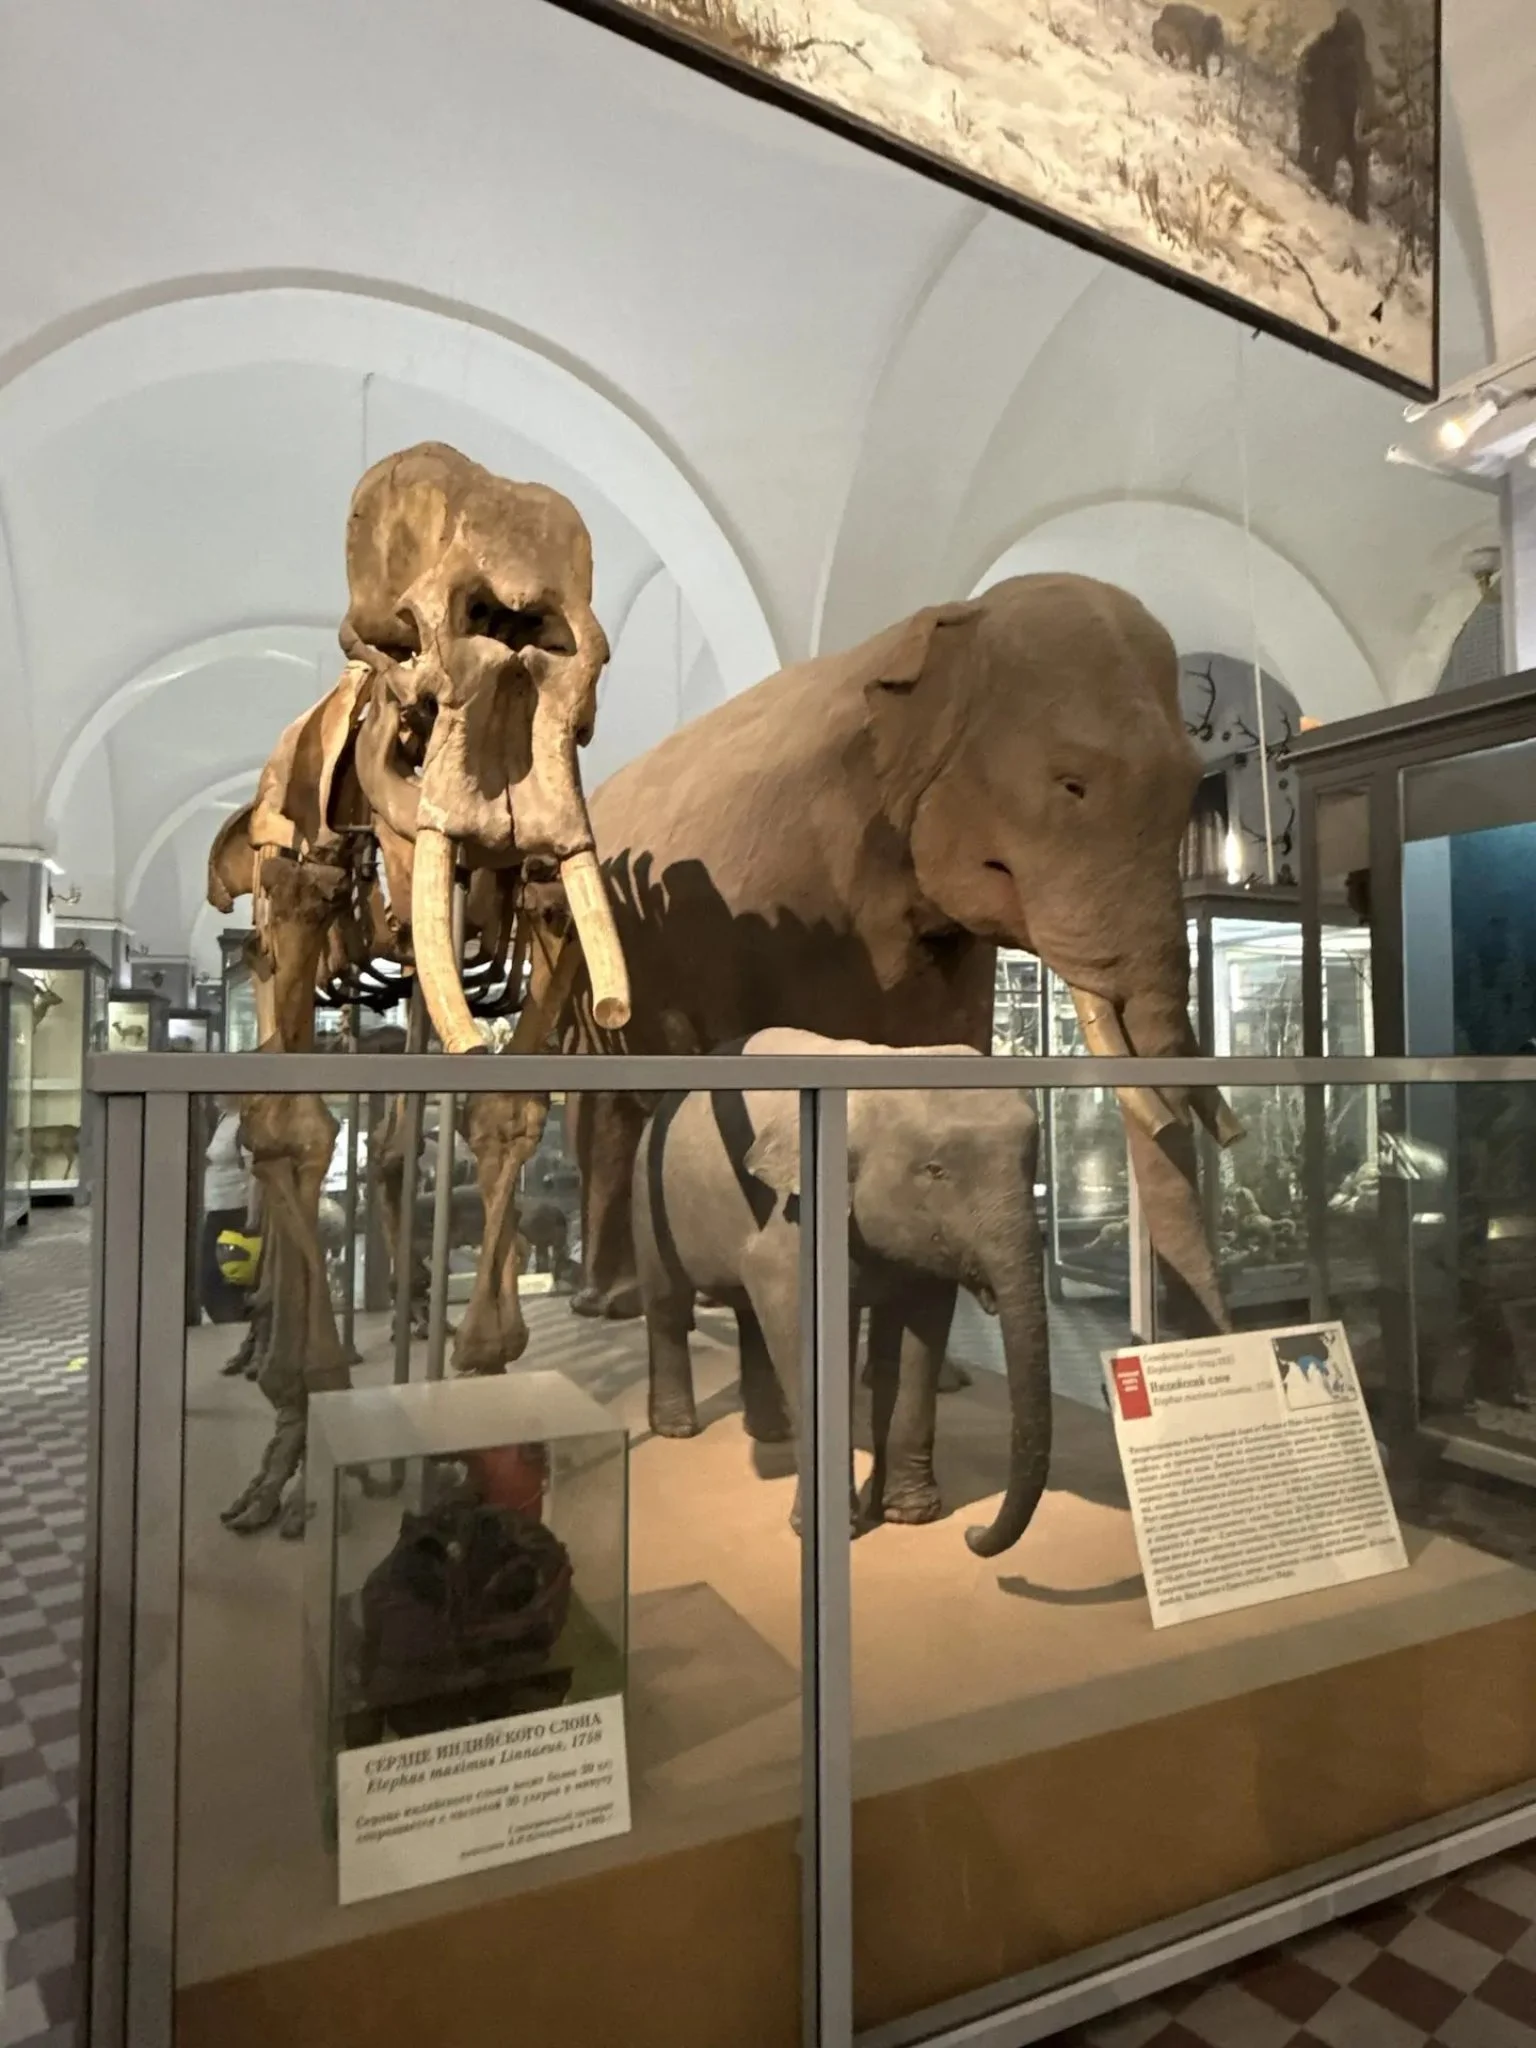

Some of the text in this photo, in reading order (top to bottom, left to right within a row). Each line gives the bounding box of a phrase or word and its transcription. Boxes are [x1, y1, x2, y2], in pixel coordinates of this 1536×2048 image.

[364, 1712, 602, 1775] СЕРДЦЕ ИНДИЙСКОГО СЛОНА
[366, 1771, 426, 1795] Elephas
[429, 1756, 495, 1780] maximus
[572, 1729, 602, 1748] 1758
